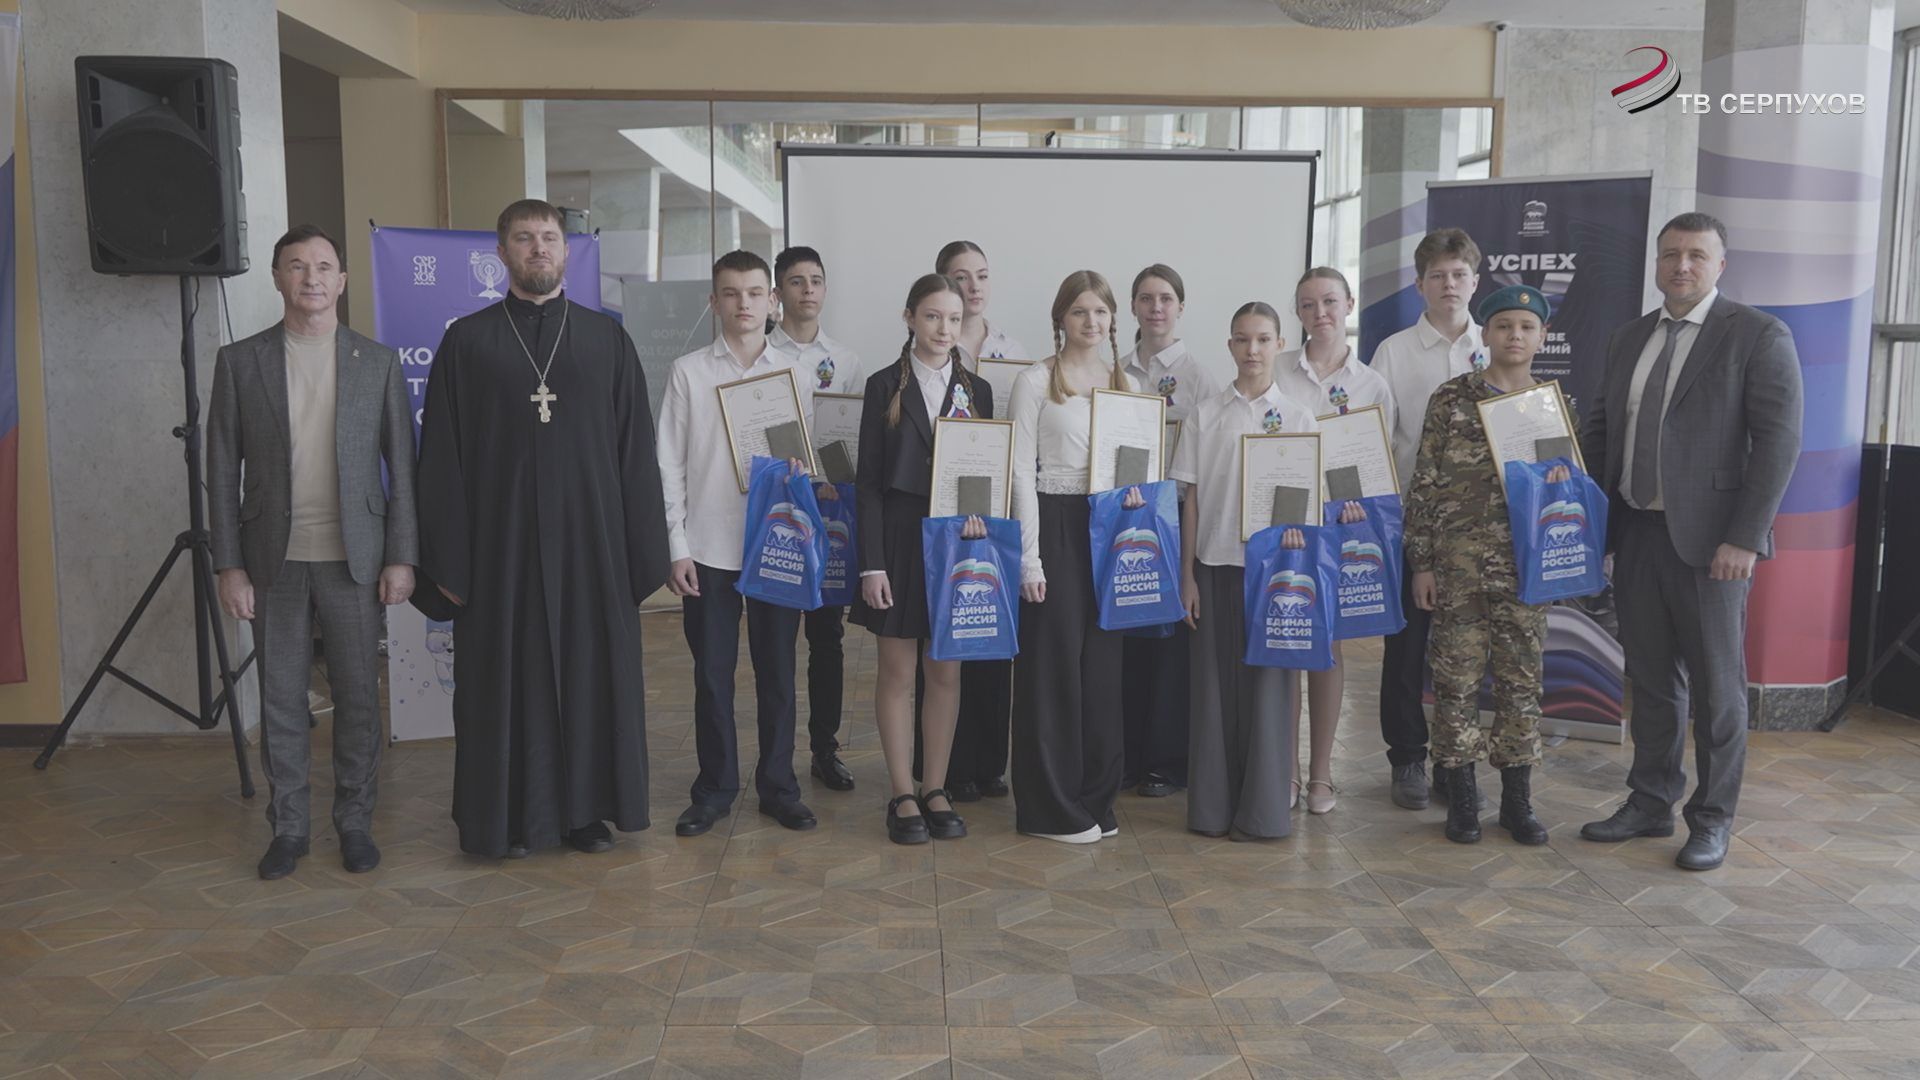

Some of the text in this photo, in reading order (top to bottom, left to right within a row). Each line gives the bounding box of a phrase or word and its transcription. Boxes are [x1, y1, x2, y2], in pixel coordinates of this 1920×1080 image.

[1487, 253, 1577, 272] УСПЕХ
[398, 346, 434, 366] КО
[762, 546, 805, 563] ЕДИНАЯ
[760, 554, 805, 573] РОССИЯ
[1542, 553, 1586, 569] РОССИЯ
[1114, 572, 1159, 584] ЕДИНАЯ
[1114, 581, 1160, 593] РОССИЯ
[1338, 583, 1383, 596] ЕДИНАЯ
[1339, 592, 1384, 604] РОССИЯ
[952, 605, 997, 617] ЕДИНАЯ
[952, 614, 997, 626] РОССИЯ
[1266, 618, 1312, 627] ЕДИНАЯ
[1266, 627, 1312, 636] РОССИЯ
